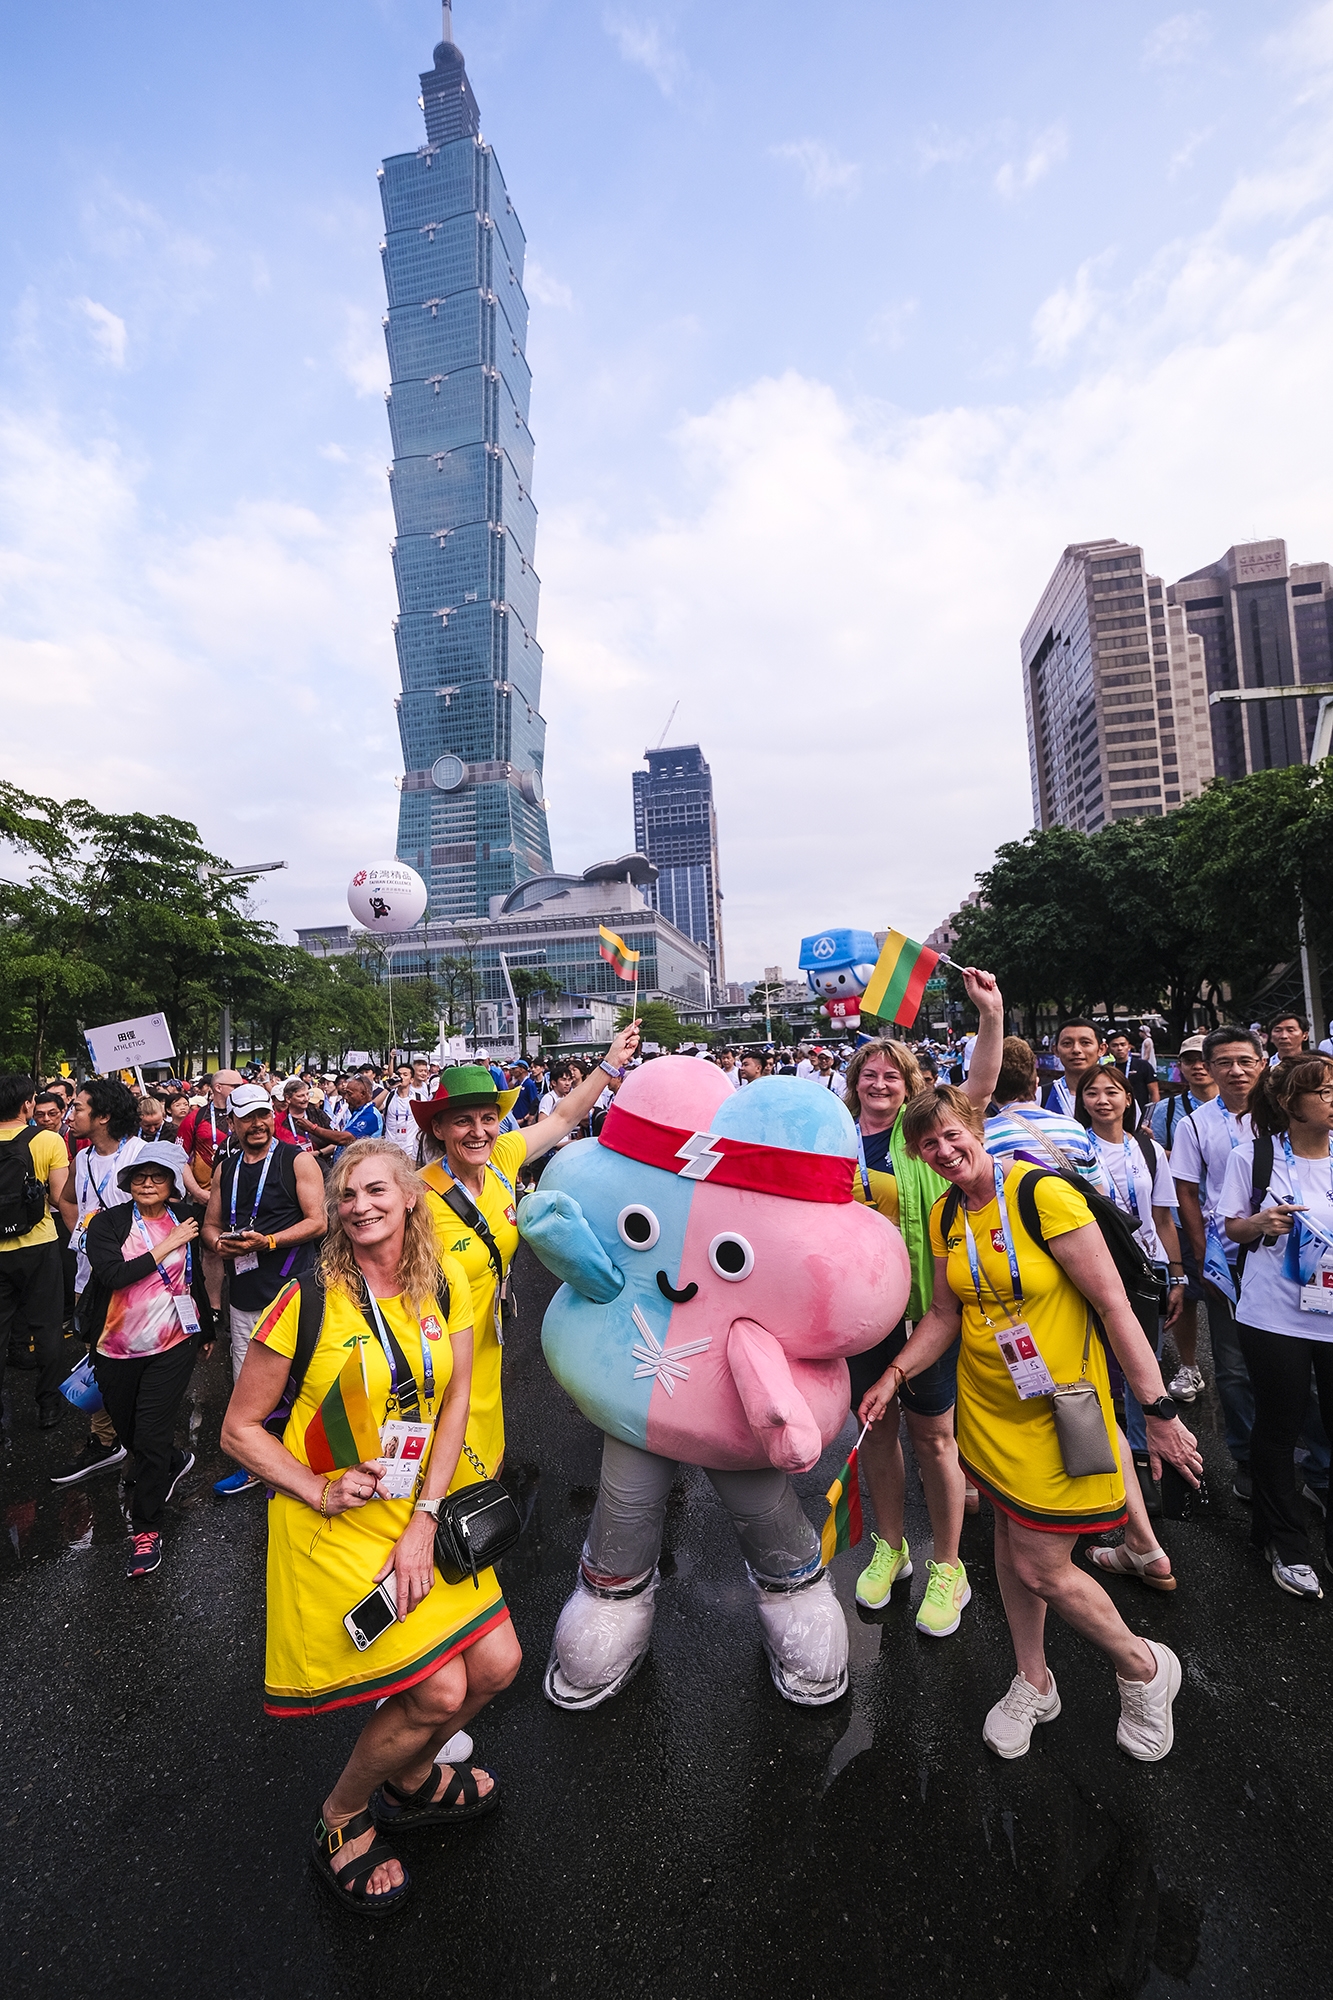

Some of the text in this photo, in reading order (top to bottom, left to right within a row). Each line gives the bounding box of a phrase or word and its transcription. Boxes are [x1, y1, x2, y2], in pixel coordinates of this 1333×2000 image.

[1240, 552, 1280, 564] GRAND
[1241, 563, 1281, 575] HYATT
[369, 870, 411, 880] 台灣精品
[833, 1003, 846, 1016] 福
[117, 1030, 136, 1042] 田徑
[113, 1039, 145, 1052] ATHLETICS
